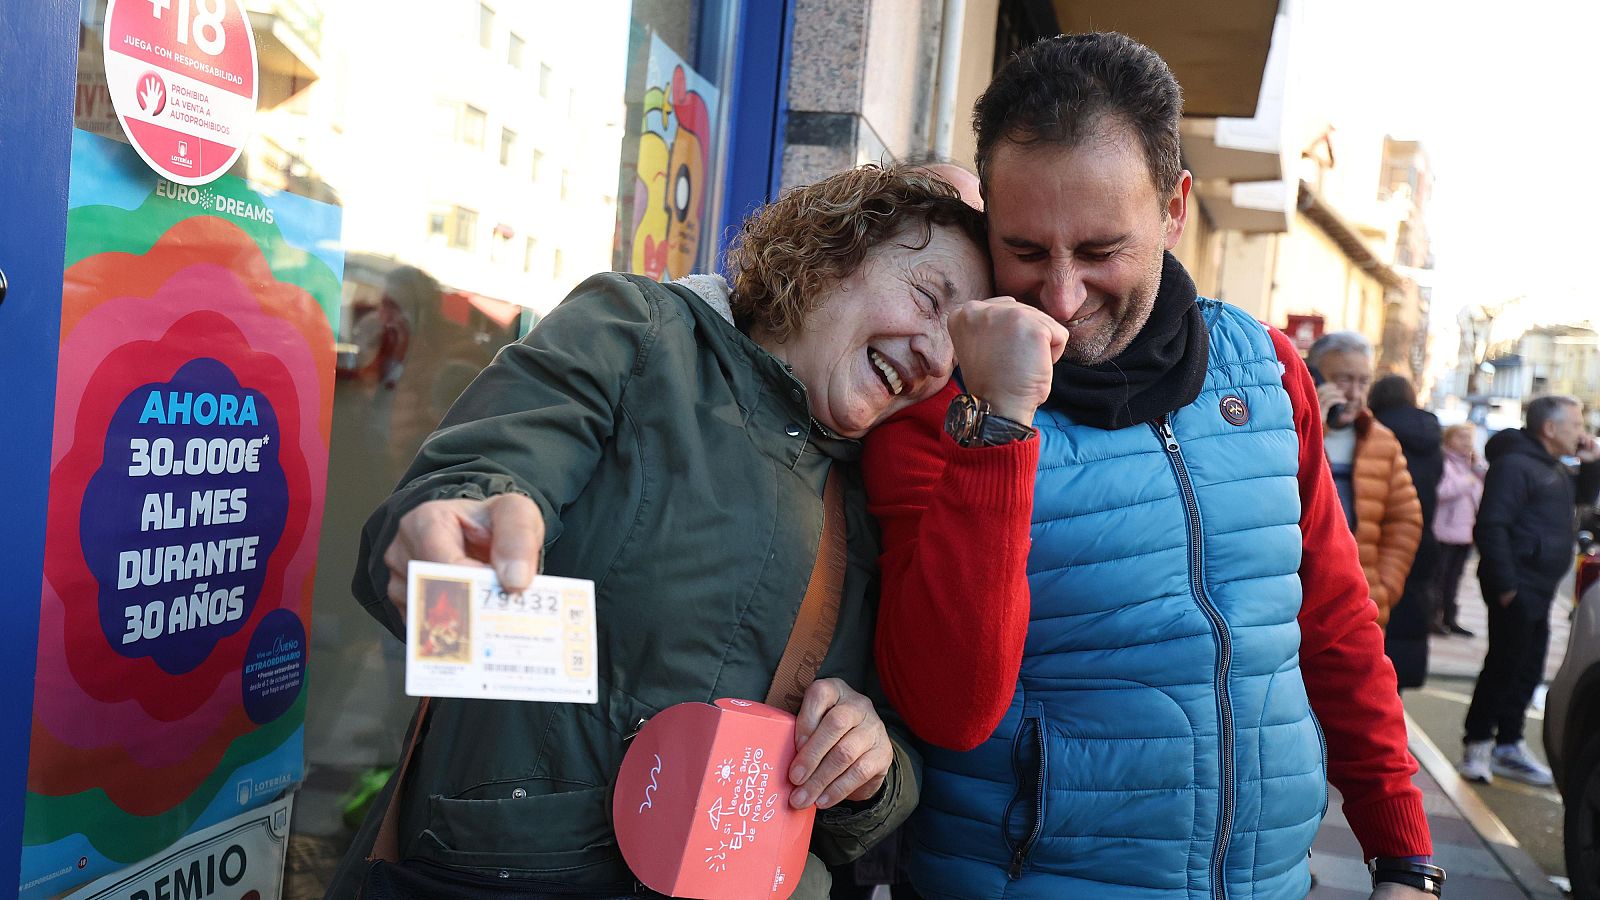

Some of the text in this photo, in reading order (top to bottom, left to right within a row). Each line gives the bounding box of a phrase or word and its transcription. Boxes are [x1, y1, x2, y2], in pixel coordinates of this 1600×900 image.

[124, 34, 243, 85] JUEGA CON RESPONSABILIDAD
[170, 97, 211, 117] LA VENTA A
[171, 84, 209, 104] PROHIBIDA
[170, 110, 230, 135] AUTOPROHIBIDOS
[156, 179, 274, 224] EURO DREAMS
[139, 390, 259, 426] AHORA
[141, 488, 247, 532] AL MES
[117, 536, 260, 590] DURANTE
[122, 582, 245, 645] 30 AÑOS
[245, 651, 300, 674] EXTRAORDINARIO
[729, 820, 747, 850] EL
[746, 828, 756, 842] de
[130, 845, 247, 900] EMIO
